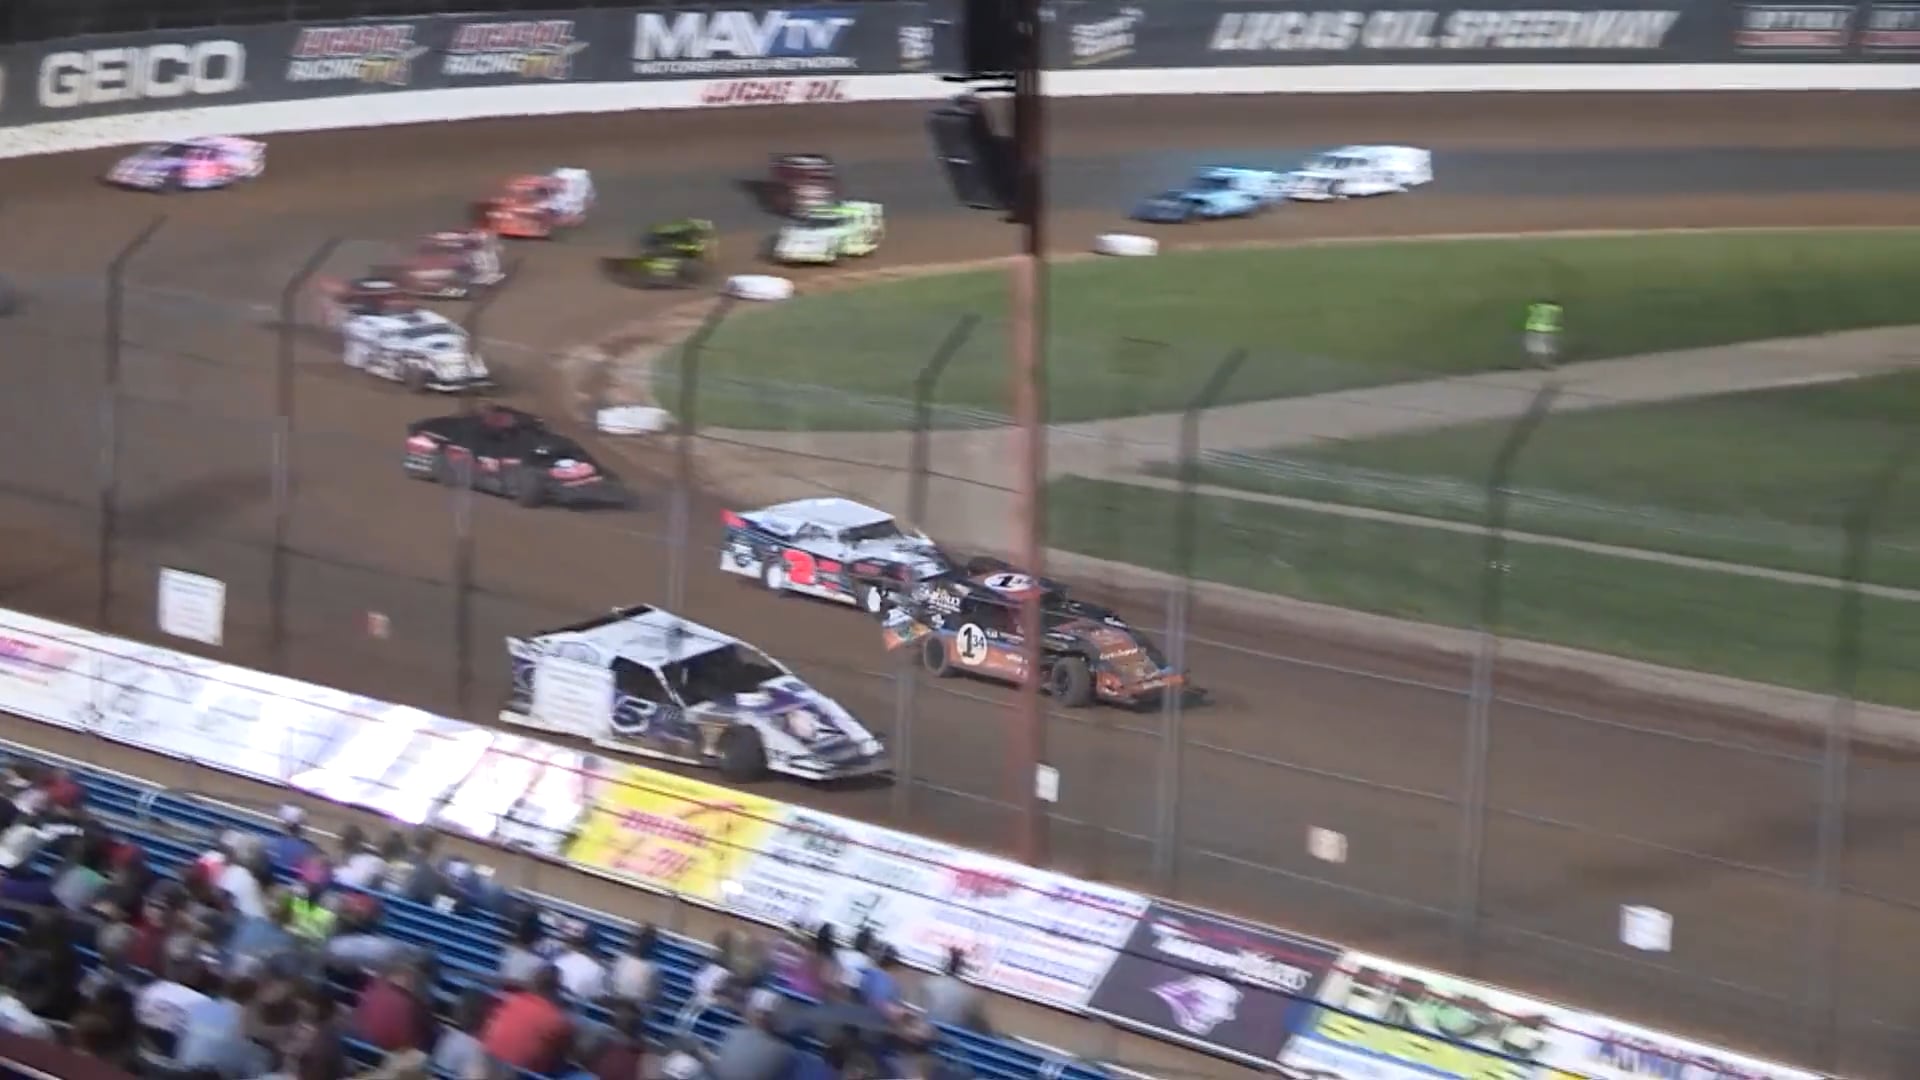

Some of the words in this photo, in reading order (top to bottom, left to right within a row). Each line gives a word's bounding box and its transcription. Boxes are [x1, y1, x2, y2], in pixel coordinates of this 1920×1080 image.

[1211, 12, 1364, 50] LUCAS
[1361, 10, 1439, 49] OIL
[1440, 10, 1681, 48] SPEEDWAY
[39, 40, 248, 107] GEICO
